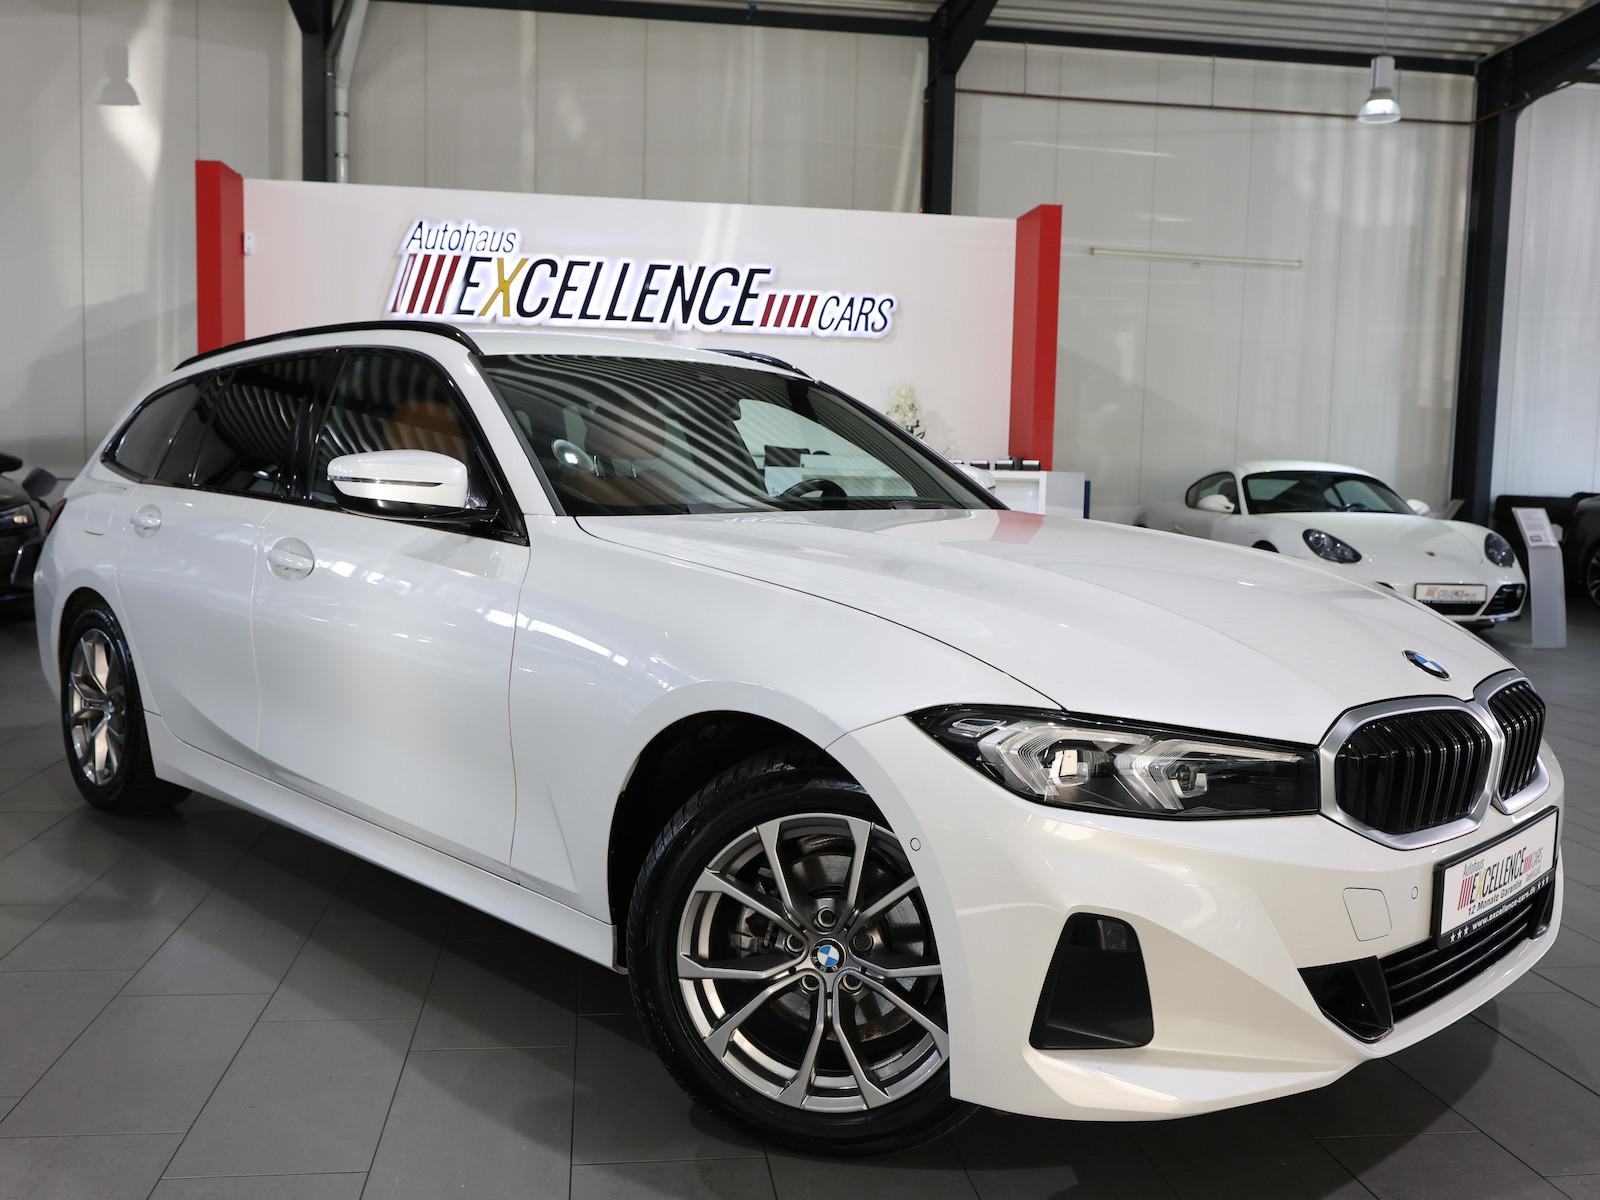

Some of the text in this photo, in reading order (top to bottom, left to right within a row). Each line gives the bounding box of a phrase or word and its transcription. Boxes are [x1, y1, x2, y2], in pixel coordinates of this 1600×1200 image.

[406, 220, 517, 254] Autohaus
[456, 256, 895, 333] EXCELLENCE CARS
[1468, 880, 1522, 916] 12 Monate Garantie
[1469, 846, 1527, 904] EXCELLENCE
